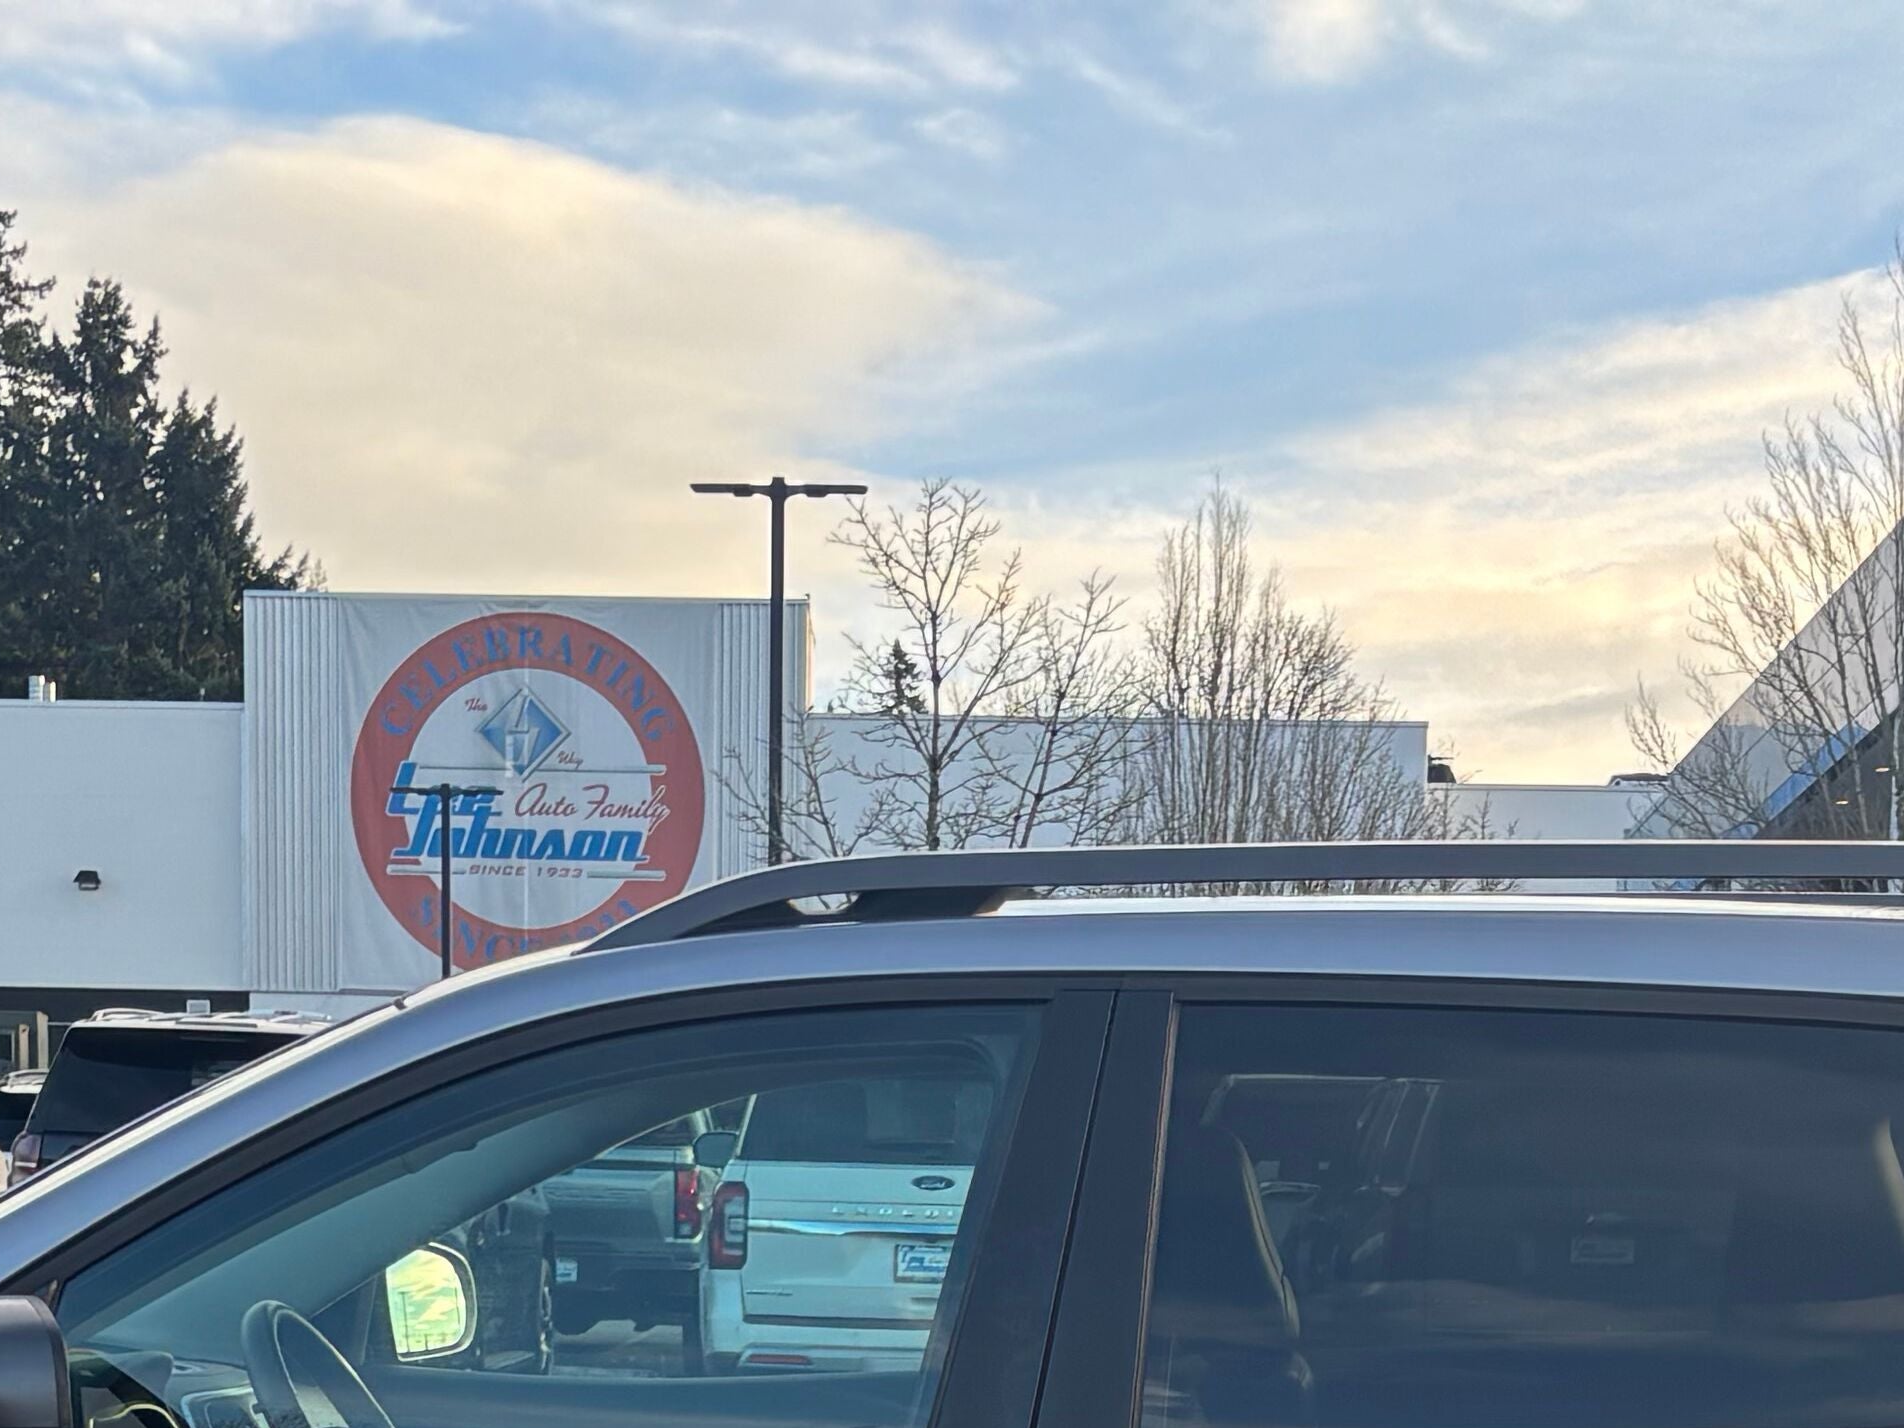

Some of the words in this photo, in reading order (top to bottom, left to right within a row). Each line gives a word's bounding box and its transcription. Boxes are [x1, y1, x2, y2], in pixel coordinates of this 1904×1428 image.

[380, 624, 675, 741] CELEBRATING
[465, 698, 489, 712] The
[557, 750, 584, 768] Way
[514, 783, 577, 818] Auto
[582, 784, 670, 835] Family
[391, 792, 649, 862] Johnson
[469, 864, 526, 876] SINCE
[537, 866, 584, 879] 1933
